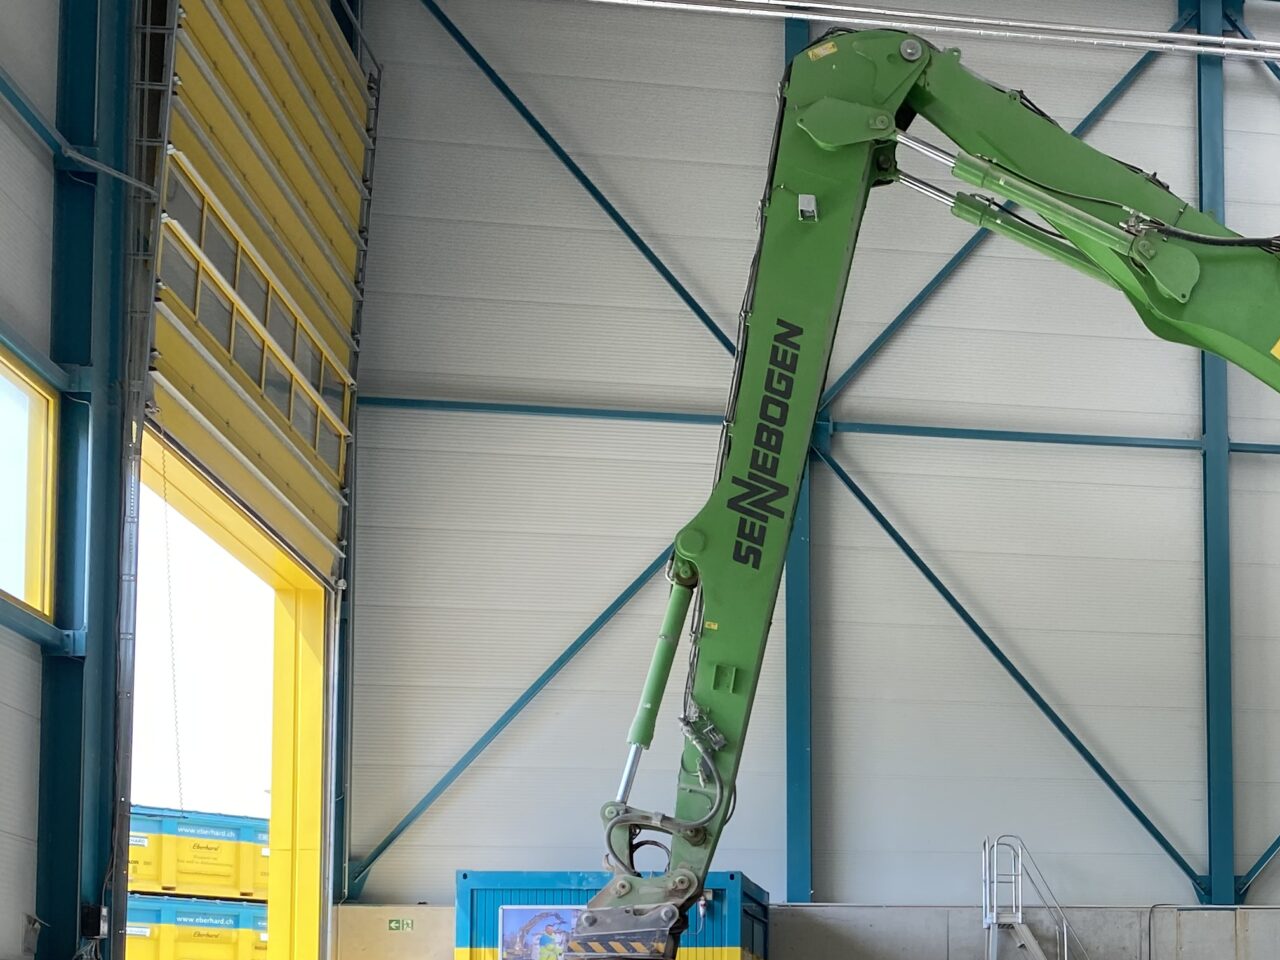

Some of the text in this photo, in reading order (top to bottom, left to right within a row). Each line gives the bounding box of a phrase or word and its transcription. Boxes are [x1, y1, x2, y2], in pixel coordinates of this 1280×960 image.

[727, 319, 804, 571] SENNEBOGEN
[177, 825, 235, 838] www.eberhard.ch
[176, 915, 234, 926] www.eberhard.ch
